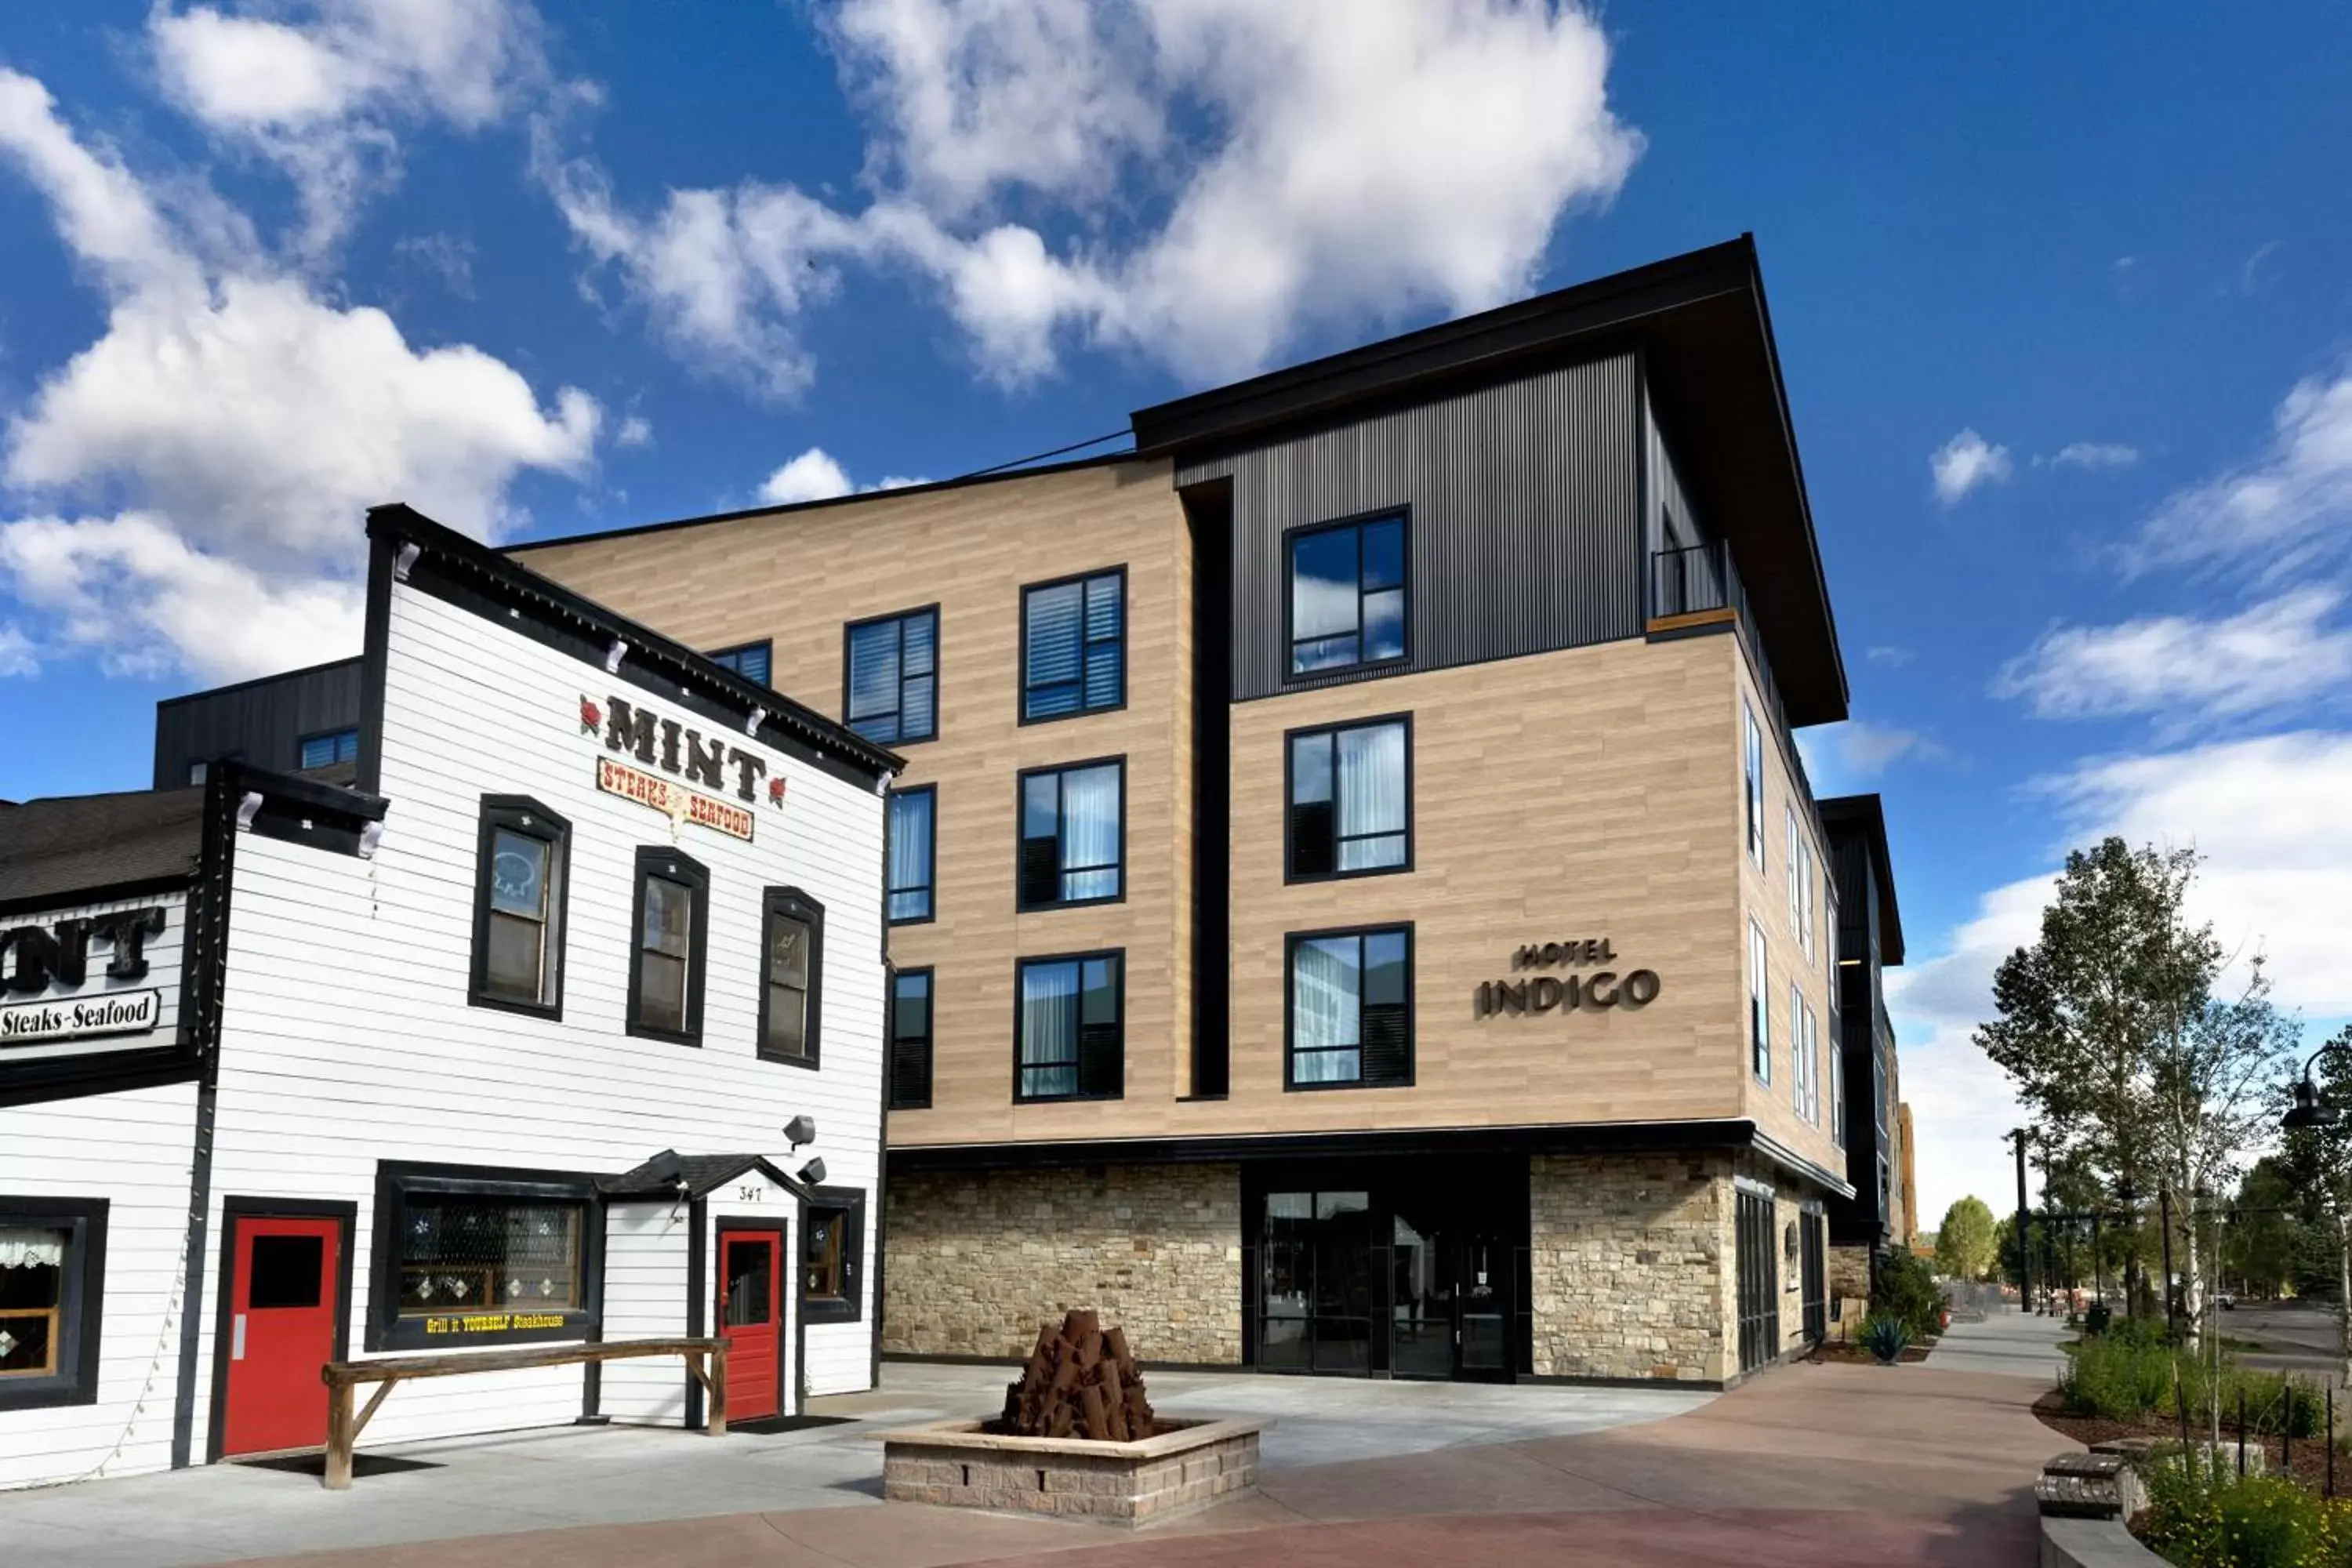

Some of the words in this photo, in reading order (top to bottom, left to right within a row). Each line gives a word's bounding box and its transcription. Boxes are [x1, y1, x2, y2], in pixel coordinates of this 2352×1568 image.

[604, 695, 767, 803] MINT
[603, 760, 667, 807] STEAKS
[689, 795, 751, 837] SEAFOOD
[1514, 938, 1617, 969] HOTEL
[1477, 969, 1660, 1018] INDIGO
[739, 1186, 761, 1201] 347
[426, 1317, 448, 1333] Grill
[452, 1317, 459, 1332] it
[463, 1315, 510, 1332] YOURSELF
